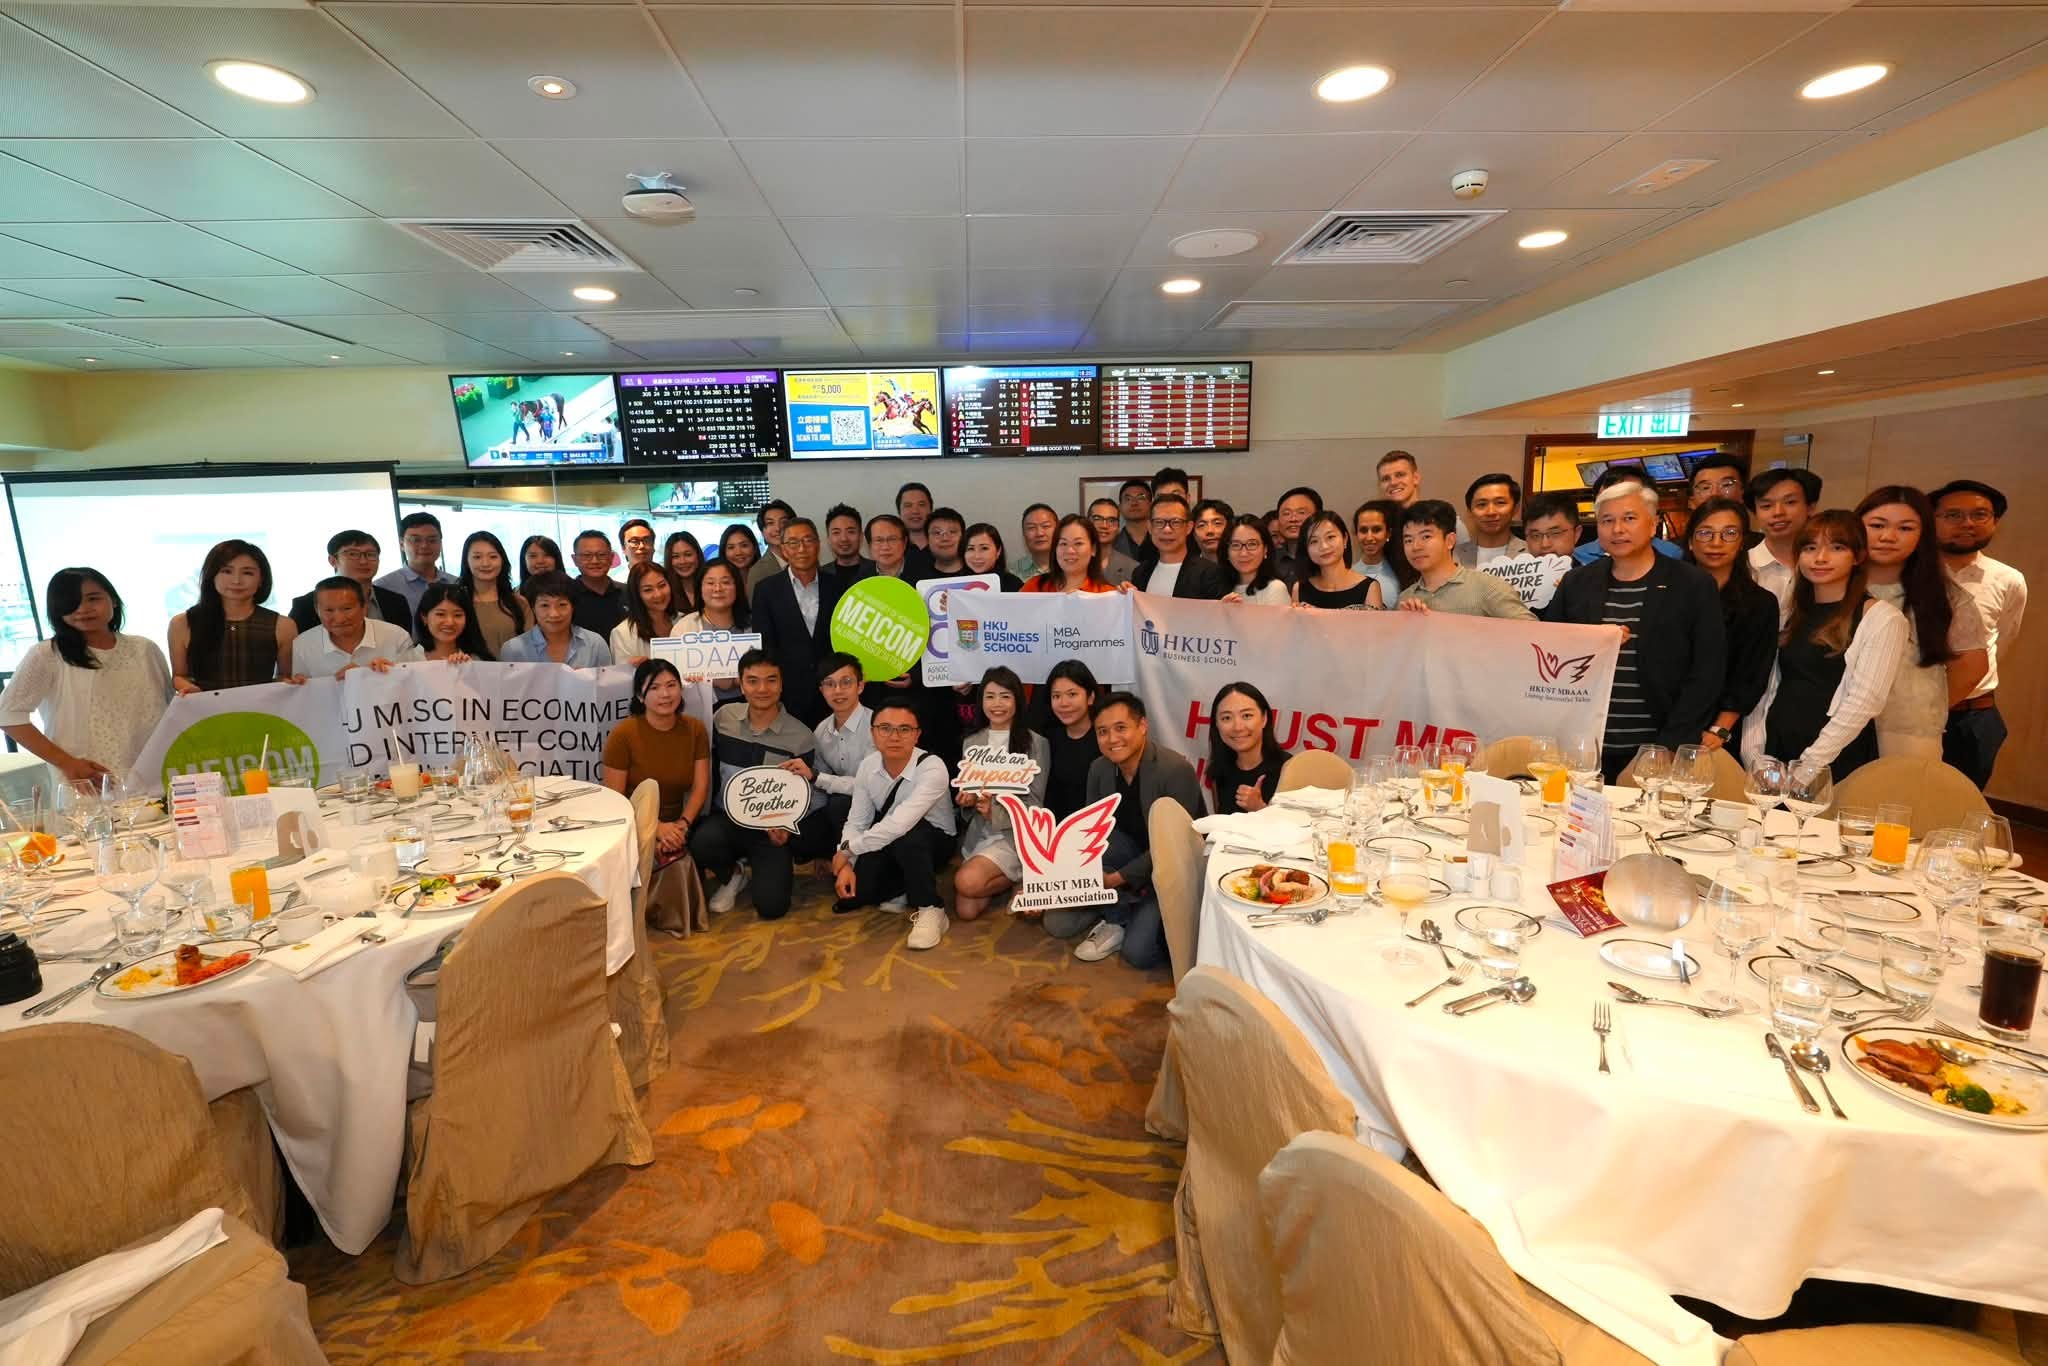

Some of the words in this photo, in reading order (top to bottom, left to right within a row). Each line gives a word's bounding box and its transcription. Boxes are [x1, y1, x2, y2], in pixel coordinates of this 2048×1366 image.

[837, 595, 924, 663] MEICOM
[984, 621, 1008, 630] HKU
[1054, 626, 1080, 638] MBA
[984, 632, 1040, 642] BUSINESS
[1054, 638, 1126, 650] Programmes
[1164, 634, 1239, 656] HKUST
[984, 642, 1033, 654] SCHOOL
[1162, 652, 1201, 664] BUSINESS
[1204, 656, 1238, 666] SCHOOL
[928, 664, 948, 674] ASSOC
[462, 698, 491, 720] IN
[502, 698, 630, 723] ECOMME
[1185, 700, 1380, 760] HUST
[384, 730, 528, 761] INTERET
[538, 729, 610, 753] COM
[967, 747, 1007, 766] Make
[1008, 756, 1026, 765] an
[954, 761, 1039, 791] Impact
[738, 776, 787, 796] Better
[740, 794, 799, 818] Together
[1026, 880, 1068, 894] HKUST
[1071, 878, 1100, 890] MBA
[1014, 895, 1052, 908] Alumni
[1054, 890, 1115, 905] Association
